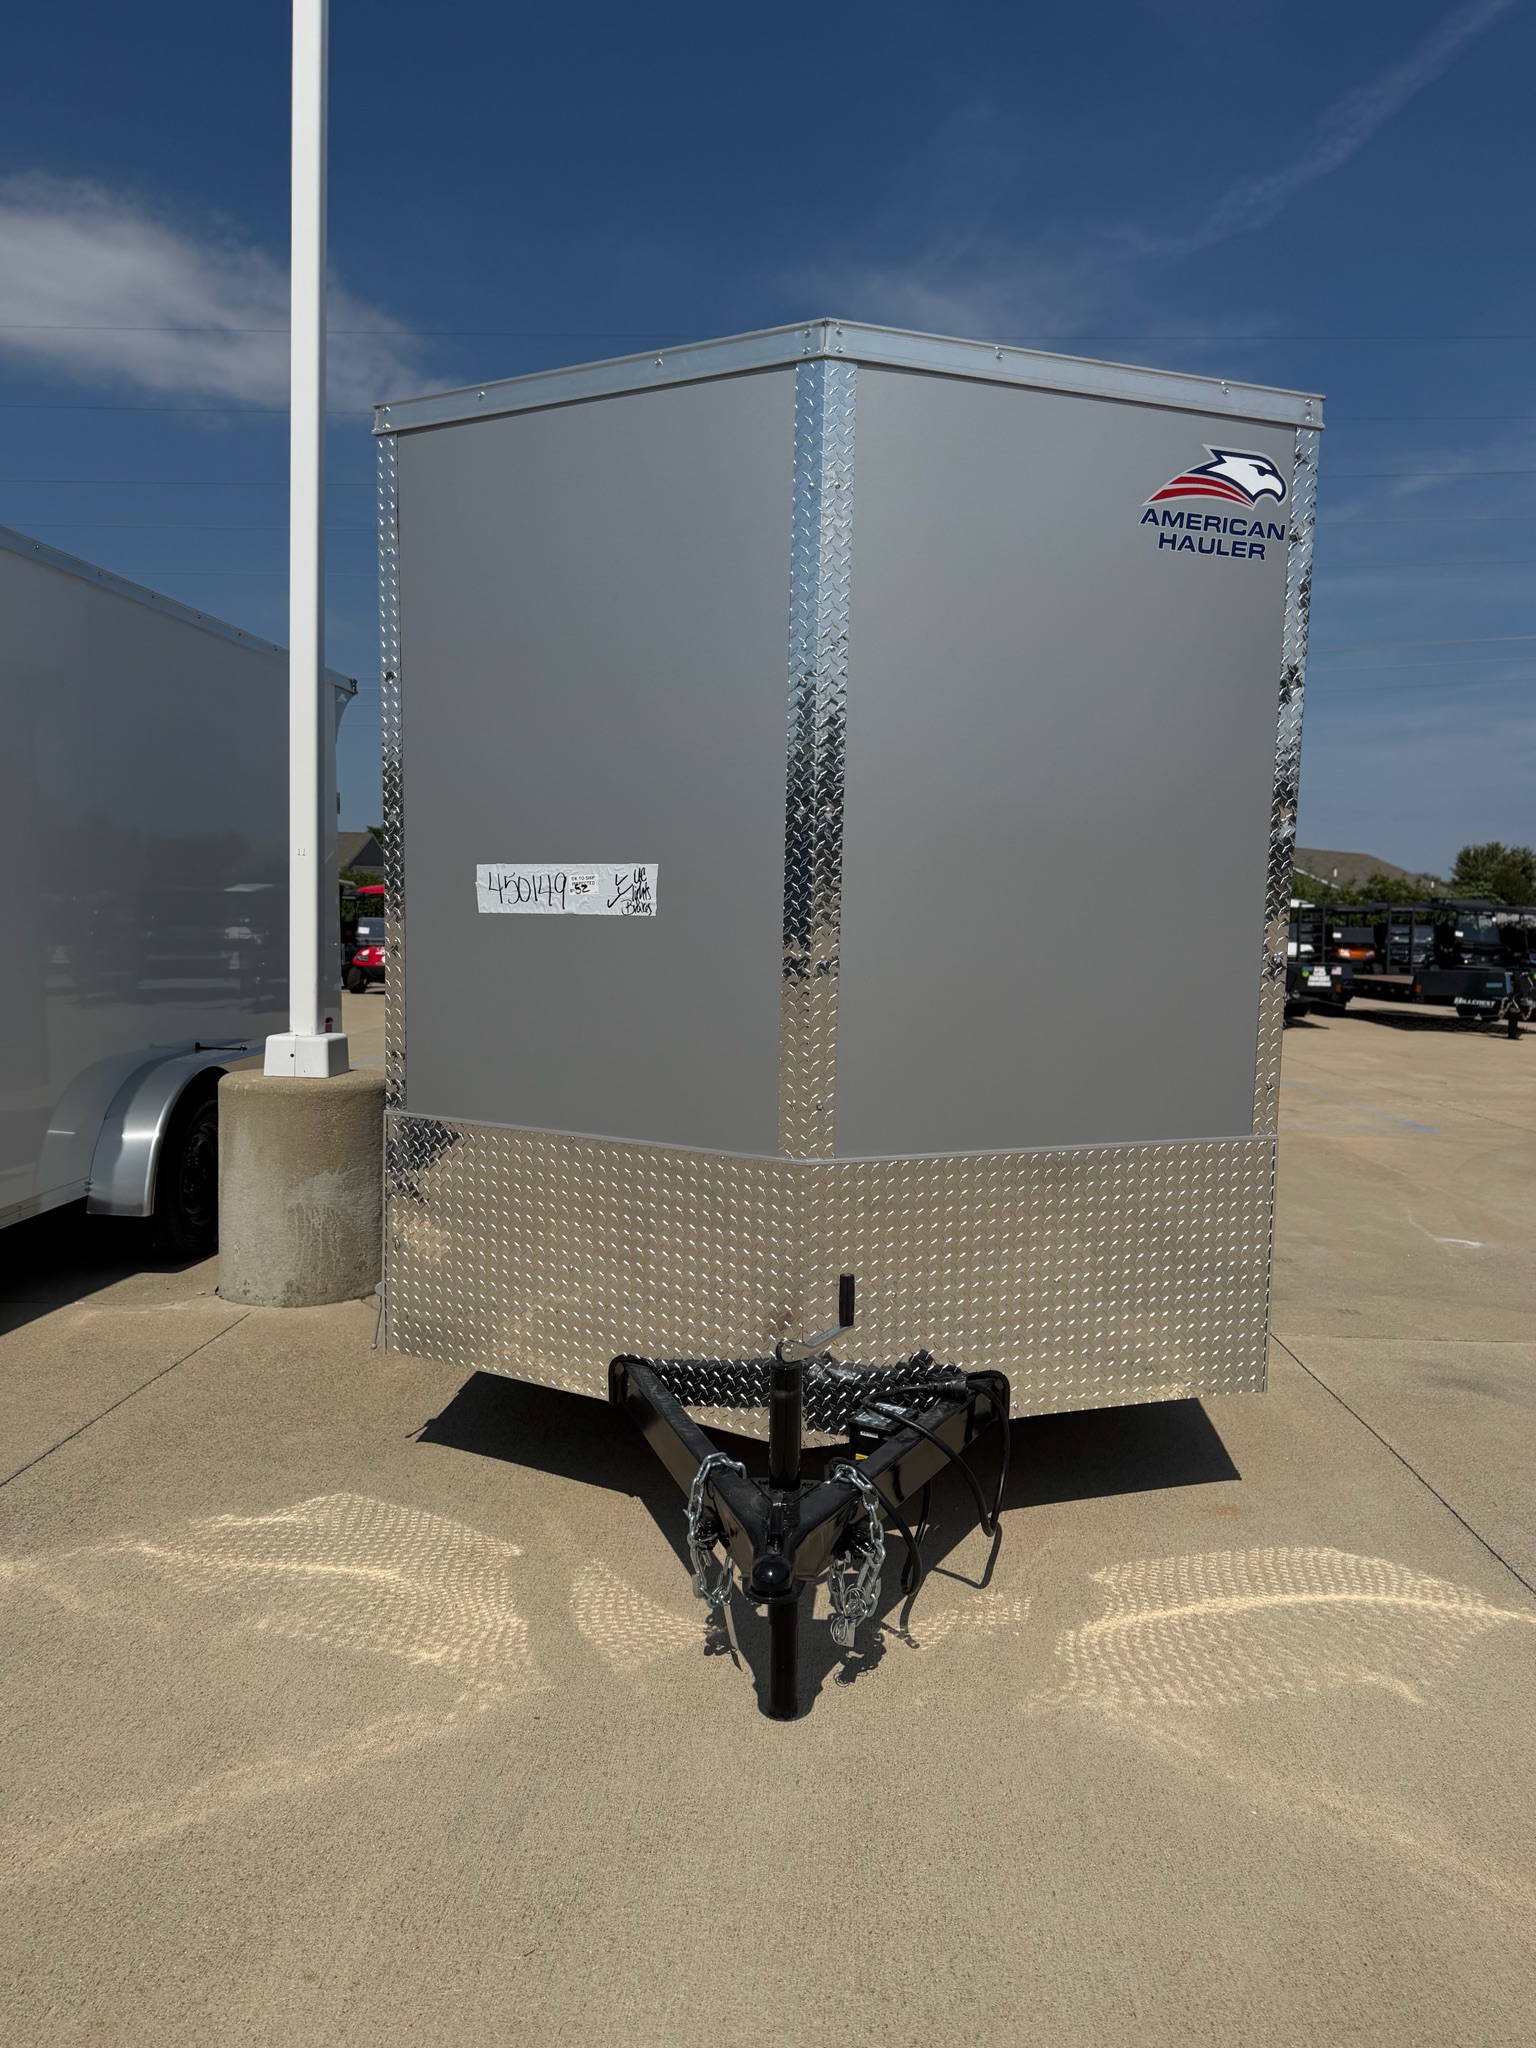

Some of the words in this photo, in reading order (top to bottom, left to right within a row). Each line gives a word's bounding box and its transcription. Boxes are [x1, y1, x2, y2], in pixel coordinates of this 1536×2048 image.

[1139, 508, 1286, 541] AMERICAN
[1158, 532, 1266, 561] HAULER
[489, 872, 567, 910] 450149
